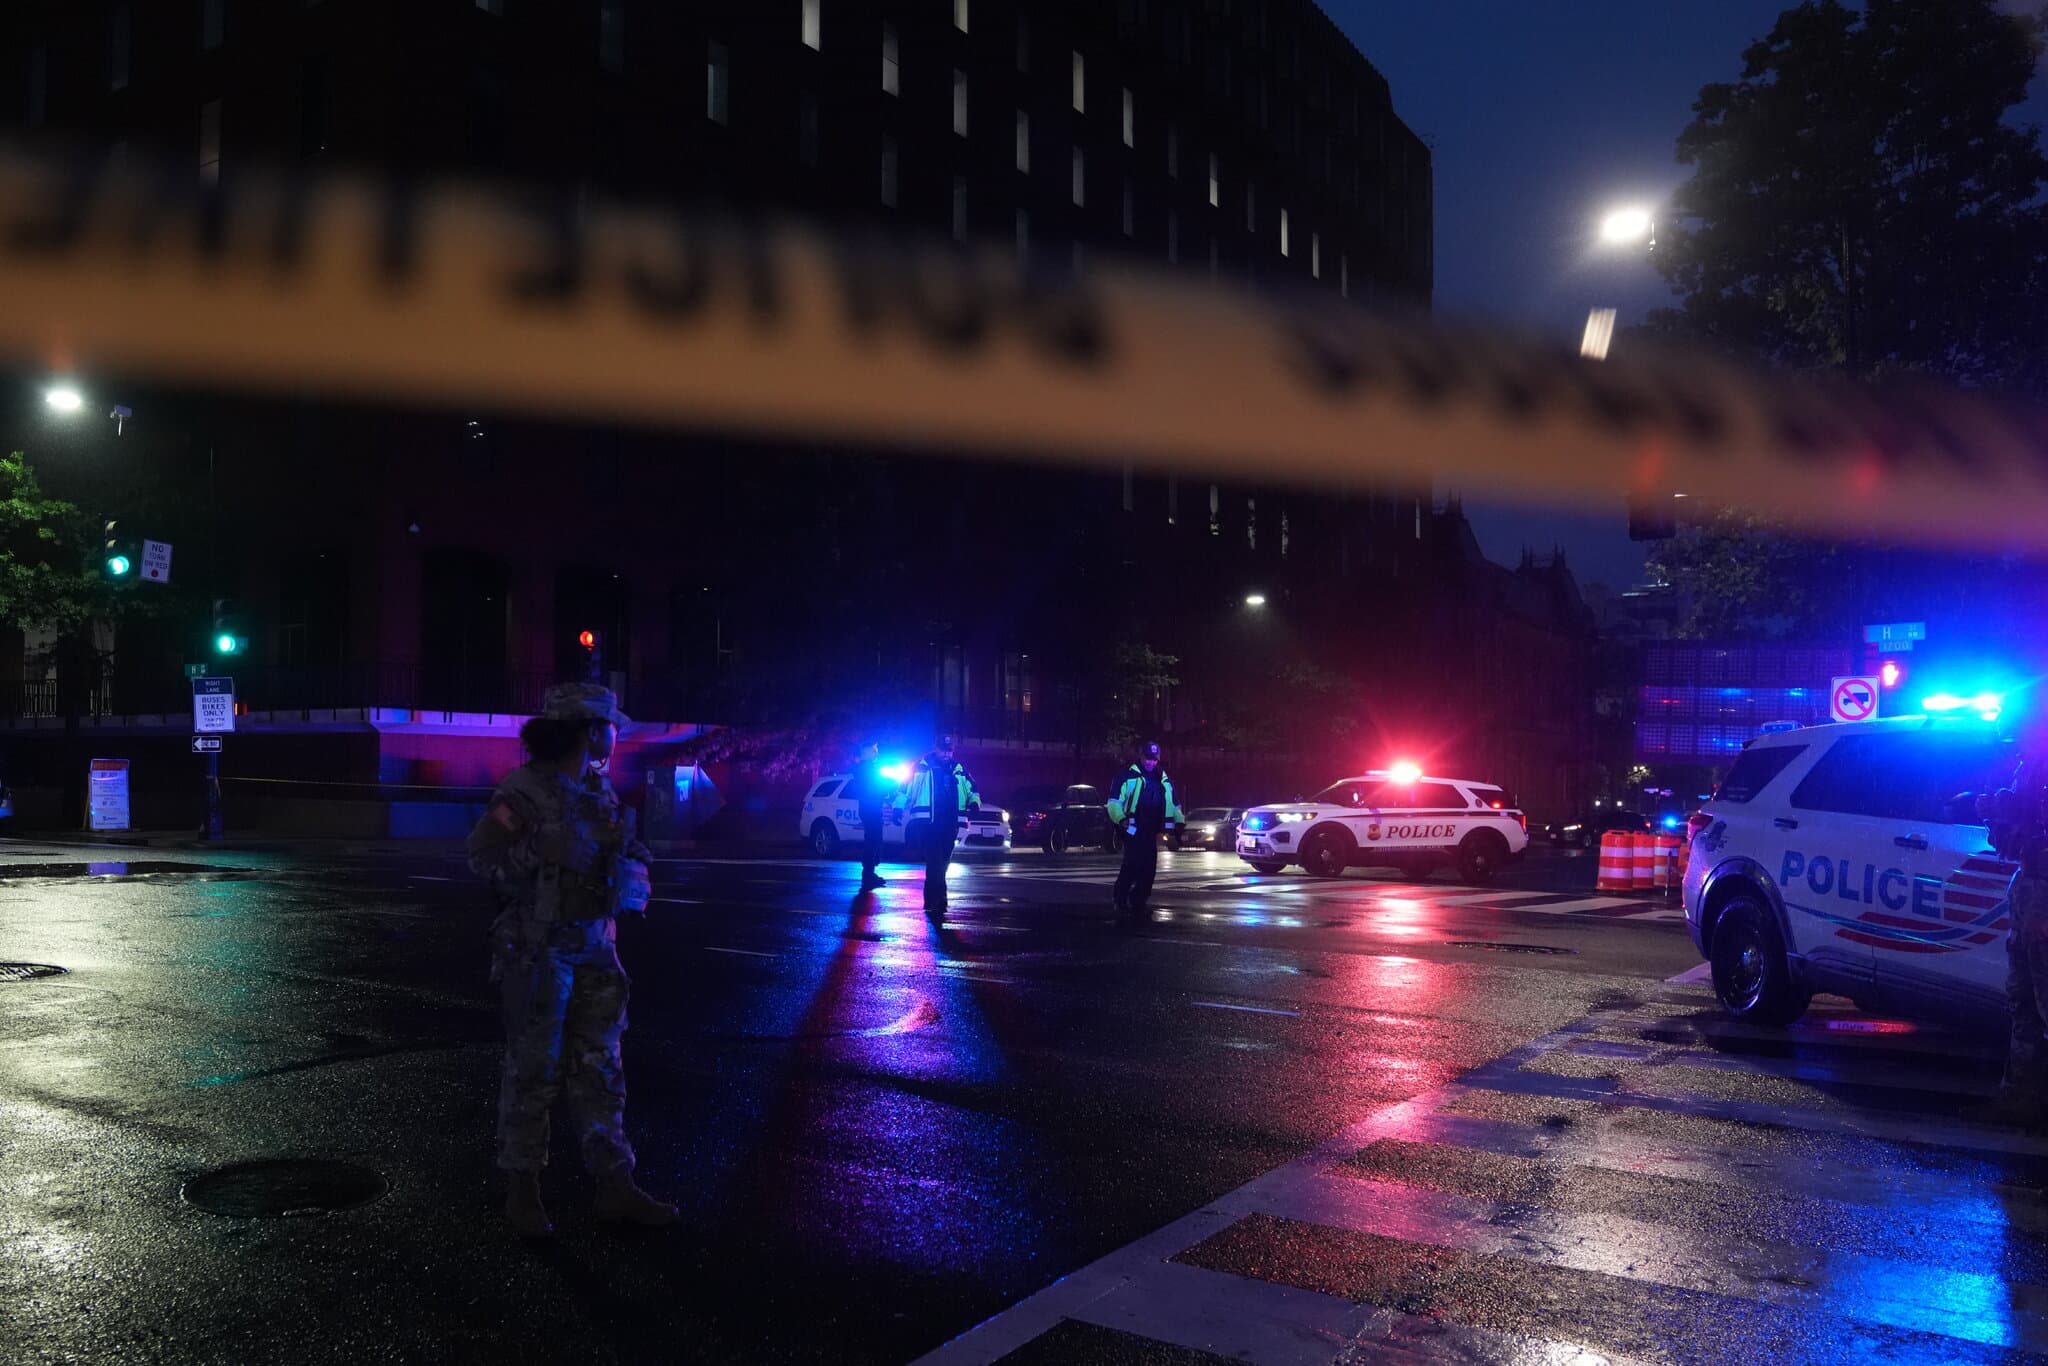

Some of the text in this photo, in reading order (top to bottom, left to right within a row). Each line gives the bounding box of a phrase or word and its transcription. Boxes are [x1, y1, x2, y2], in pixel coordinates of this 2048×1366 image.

[152, 544, 164, 553] NO
[1883, 626, 1891, 640] H
[1386, 825, 1456, 839] POLICE
[1780, 850, 1944, 919] POLICE
